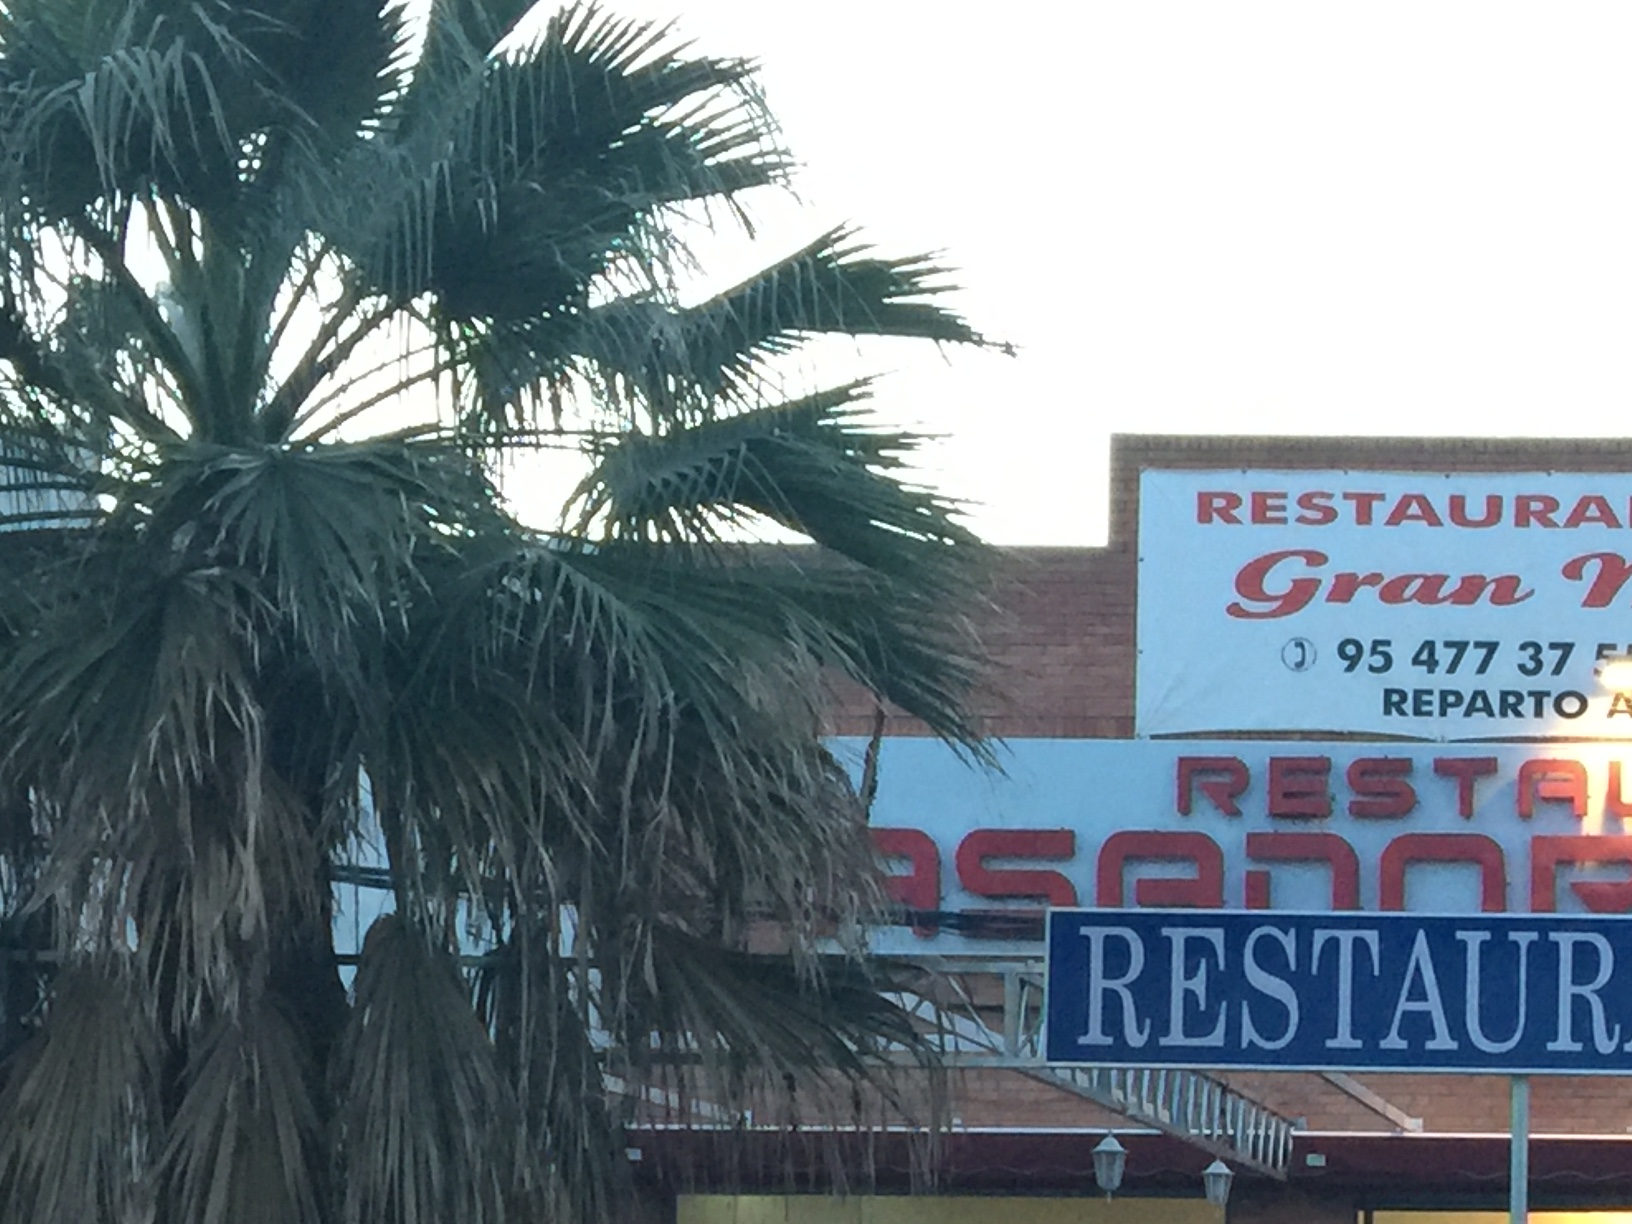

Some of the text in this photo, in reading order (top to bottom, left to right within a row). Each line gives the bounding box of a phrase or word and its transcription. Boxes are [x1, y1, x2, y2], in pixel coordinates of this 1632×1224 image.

[1226, 549, 1533, 620] Gran
[1336, 638, 1394, 675] 95
[1410, 639, 1501, 676] 477
[1516, 640, 1576, 677] 37
[1382, 687, 1589, 720] REPARTO
